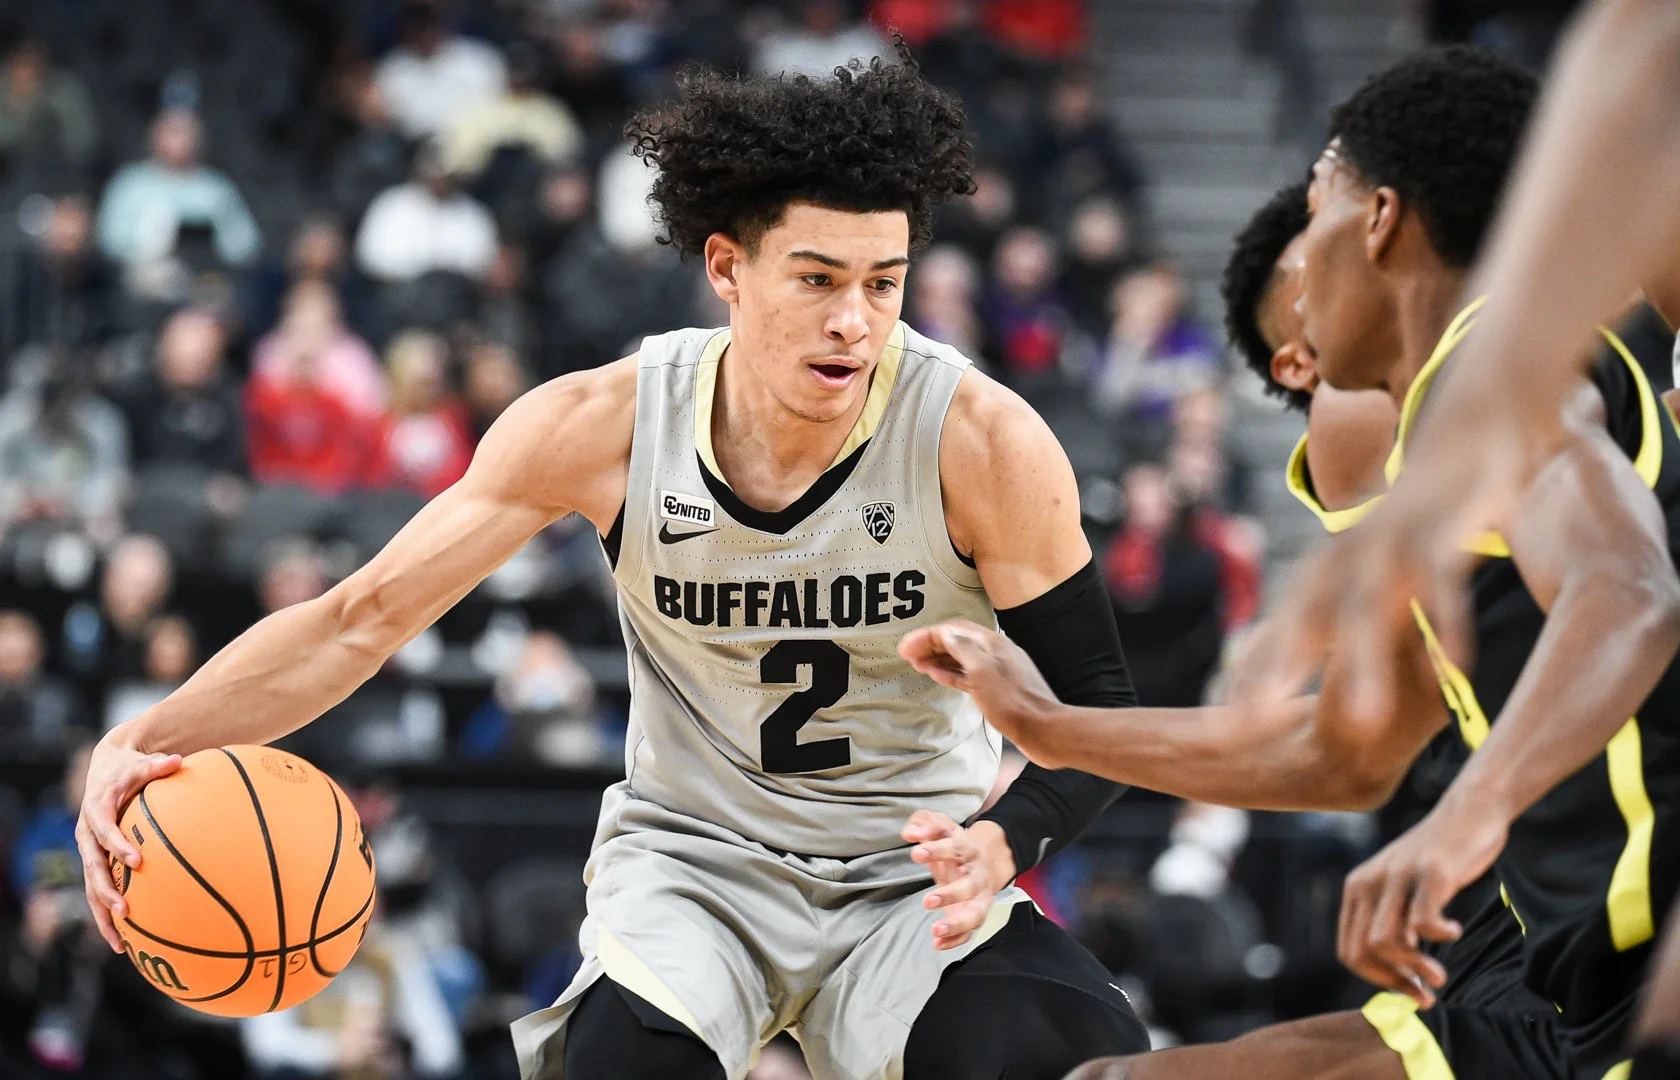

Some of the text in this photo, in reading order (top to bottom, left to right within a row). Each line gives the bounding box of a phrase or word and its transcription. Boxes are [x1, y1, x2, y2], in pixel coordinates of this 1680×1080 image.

[862, 503, 894, 530] PAC
[871, 520, 889, 538] 12
[654, 569, 926, 629] BUFFALOES
[760, 639, 852, 774] 2
